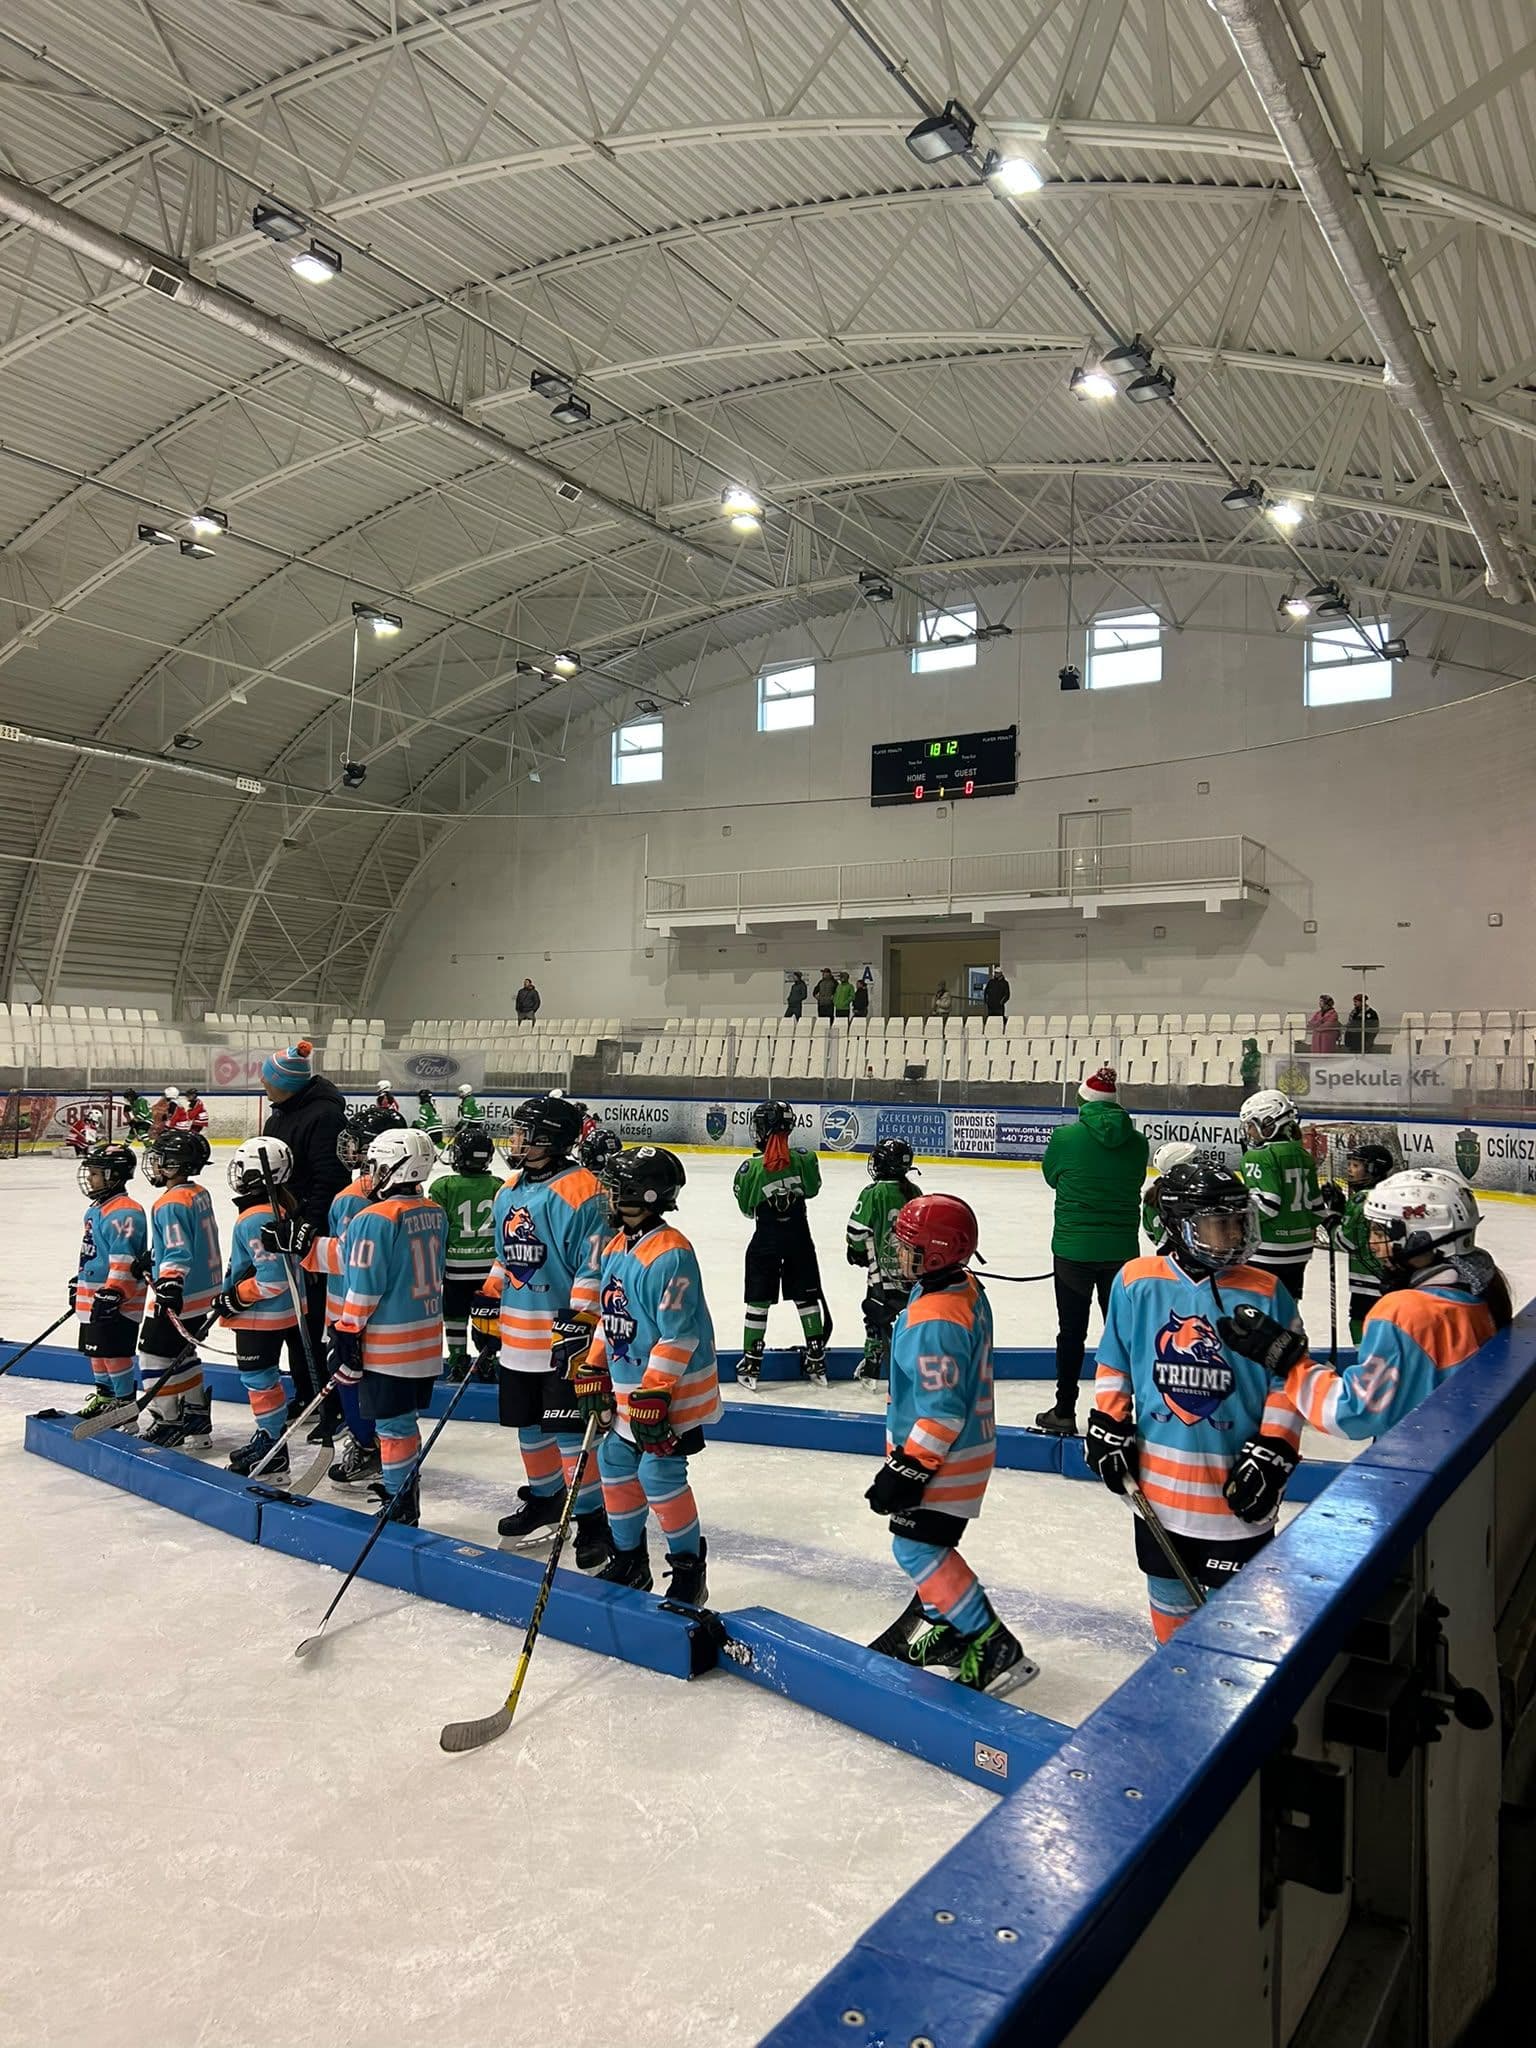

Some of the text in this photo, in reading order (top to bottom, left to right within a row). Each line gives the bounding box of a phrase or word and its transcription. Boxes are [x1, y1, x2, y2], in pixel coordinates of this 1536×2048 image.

[907, 773, 926, 782] HOME
[954, 768, 977, 777] GUEST
[915, 786, 923, 799] 0
[965, 781, 974, 794] 0
[415, 1057, 449, 1075] Ford
[1315, 1069, 1445, 1089] Spekula Kft.
[604, 1104, 669, 1122] CSÍKRÁKOS
[954, 1115, 983, 1126] ORVOSI
[620, 1123, 652, 1138] község
[954, 1127, 995, 1139] METODIKAI
[1245, 1163, 1262, 1179] 76
[457, 1200, 496, 1238] 12
[165, 1223, 184, 1249] 11
[350, 1239, 375, 1269] 10
[918, 1355, 959, 1392] 50
[1156, 1362, 1231, 1391] TRIUMF
[543, 1409, 581, 1419] BAUE
[1090, 1424, 1136, 1447] CCM
[1241, 1441, 1293, 1473] CCM
[885, 1454, 930, 1483] AUER
